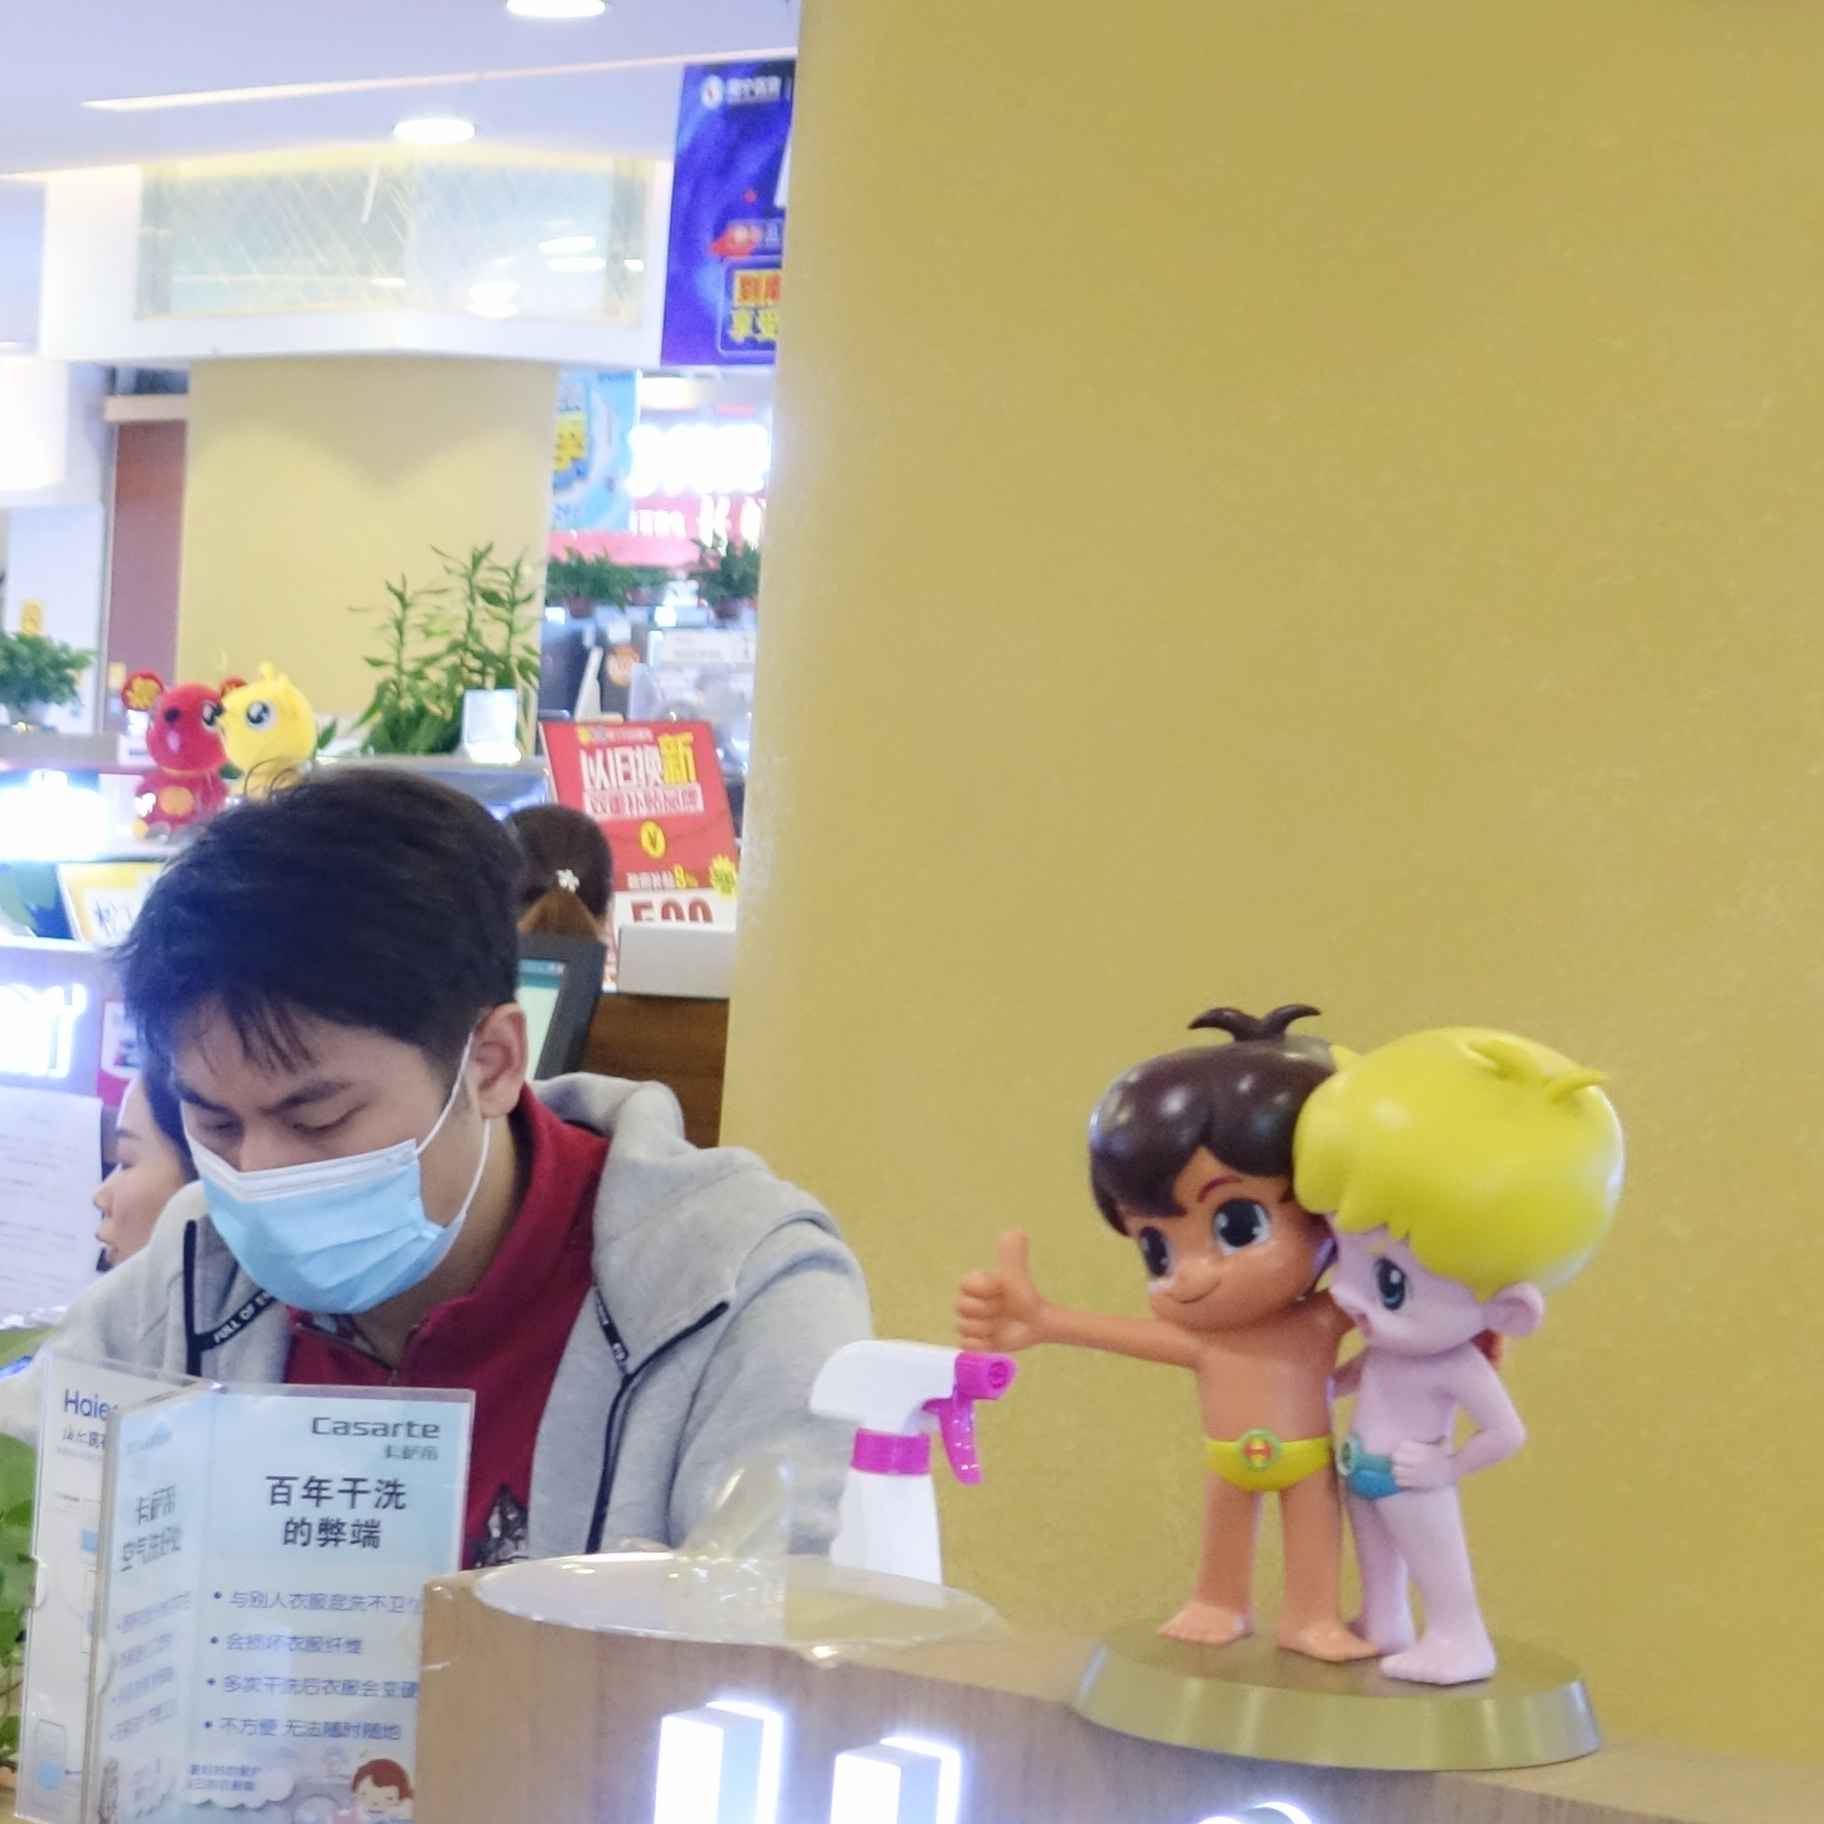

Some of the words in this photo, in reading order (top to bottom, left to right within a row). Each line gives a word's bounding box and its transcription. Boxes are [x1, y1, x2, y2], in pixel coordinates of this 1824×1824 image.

[64, 1388, 119, 1422] Haie
[311, 1415, 441, 1440] Casarte
[265, 1474, 407, 1511] 百年干洗
[282, 1517, 383, 1551] 的弊端
